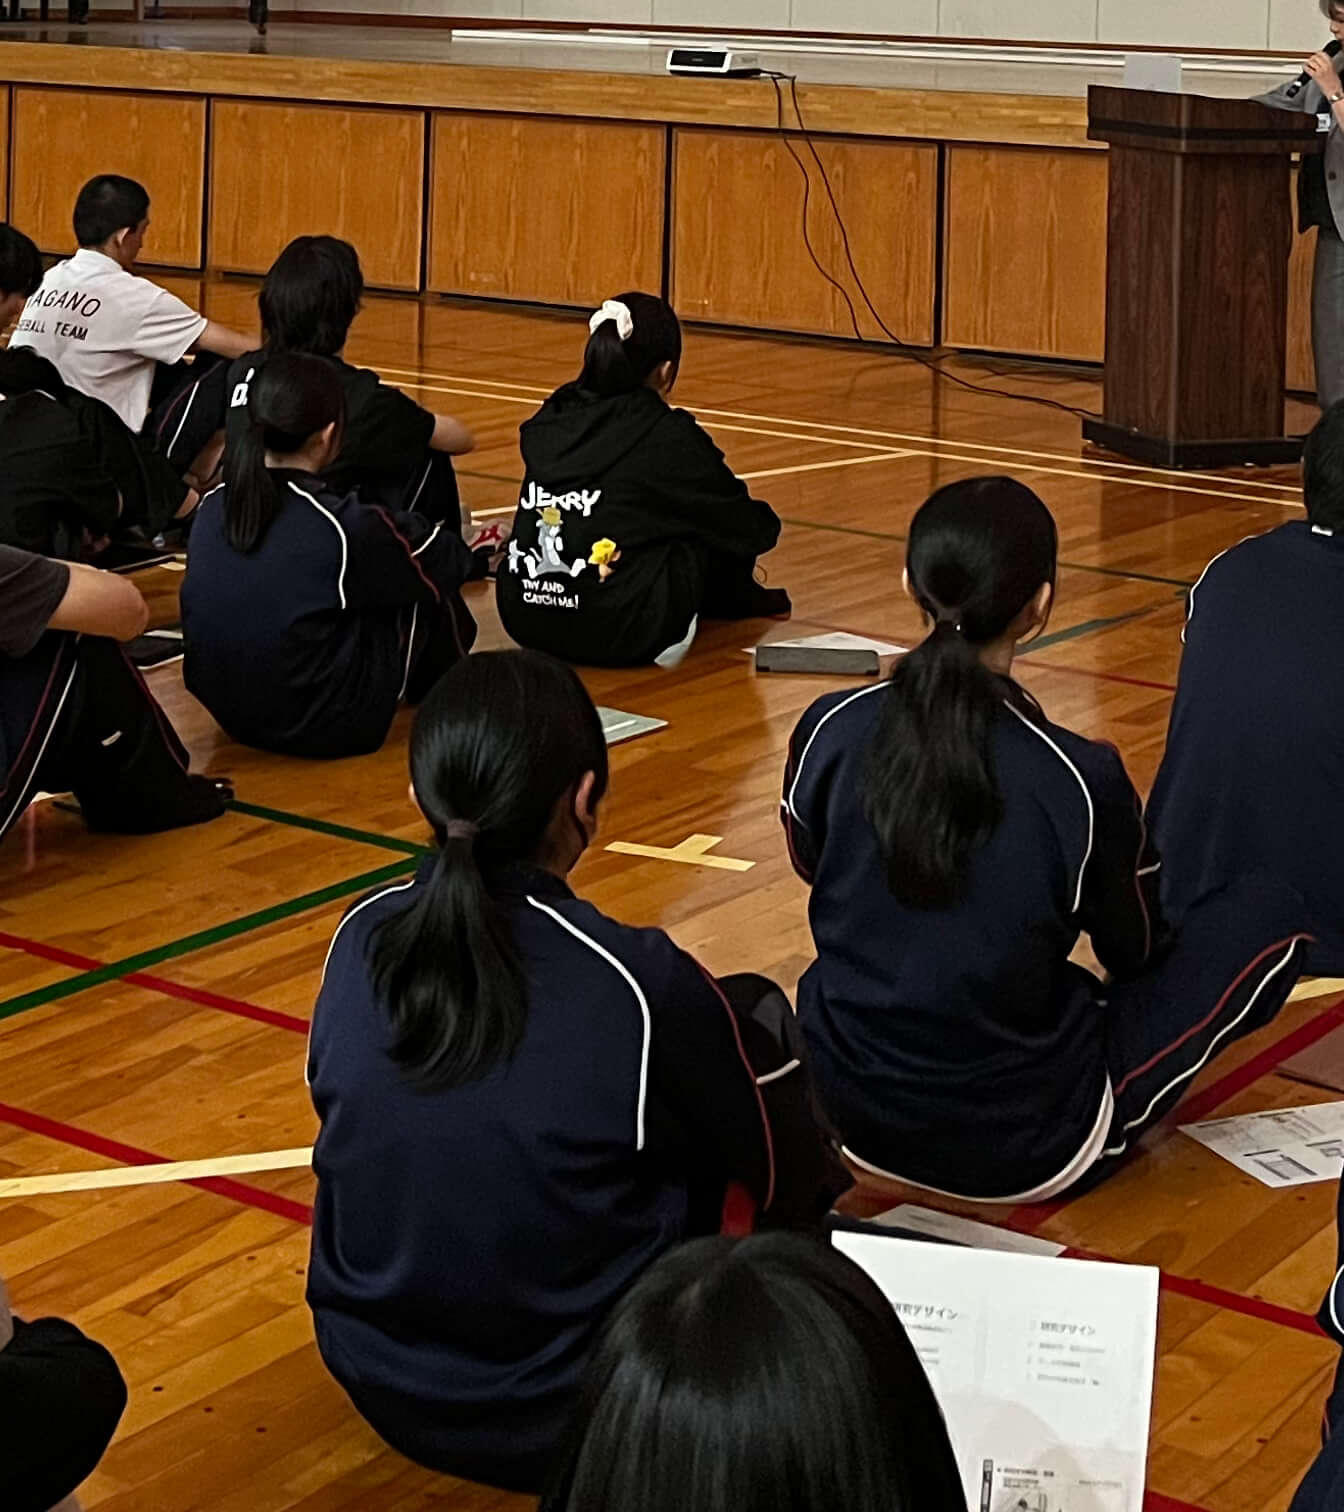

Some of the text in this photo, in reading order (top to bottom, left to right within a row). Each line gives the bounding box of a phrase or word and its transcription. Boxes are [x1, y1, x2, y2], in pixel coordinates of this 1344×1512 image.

[27, 289, 101, 317] AGANO
[54, 321, 89, 341] TEAM
[541, 580, 565, 594] AND
